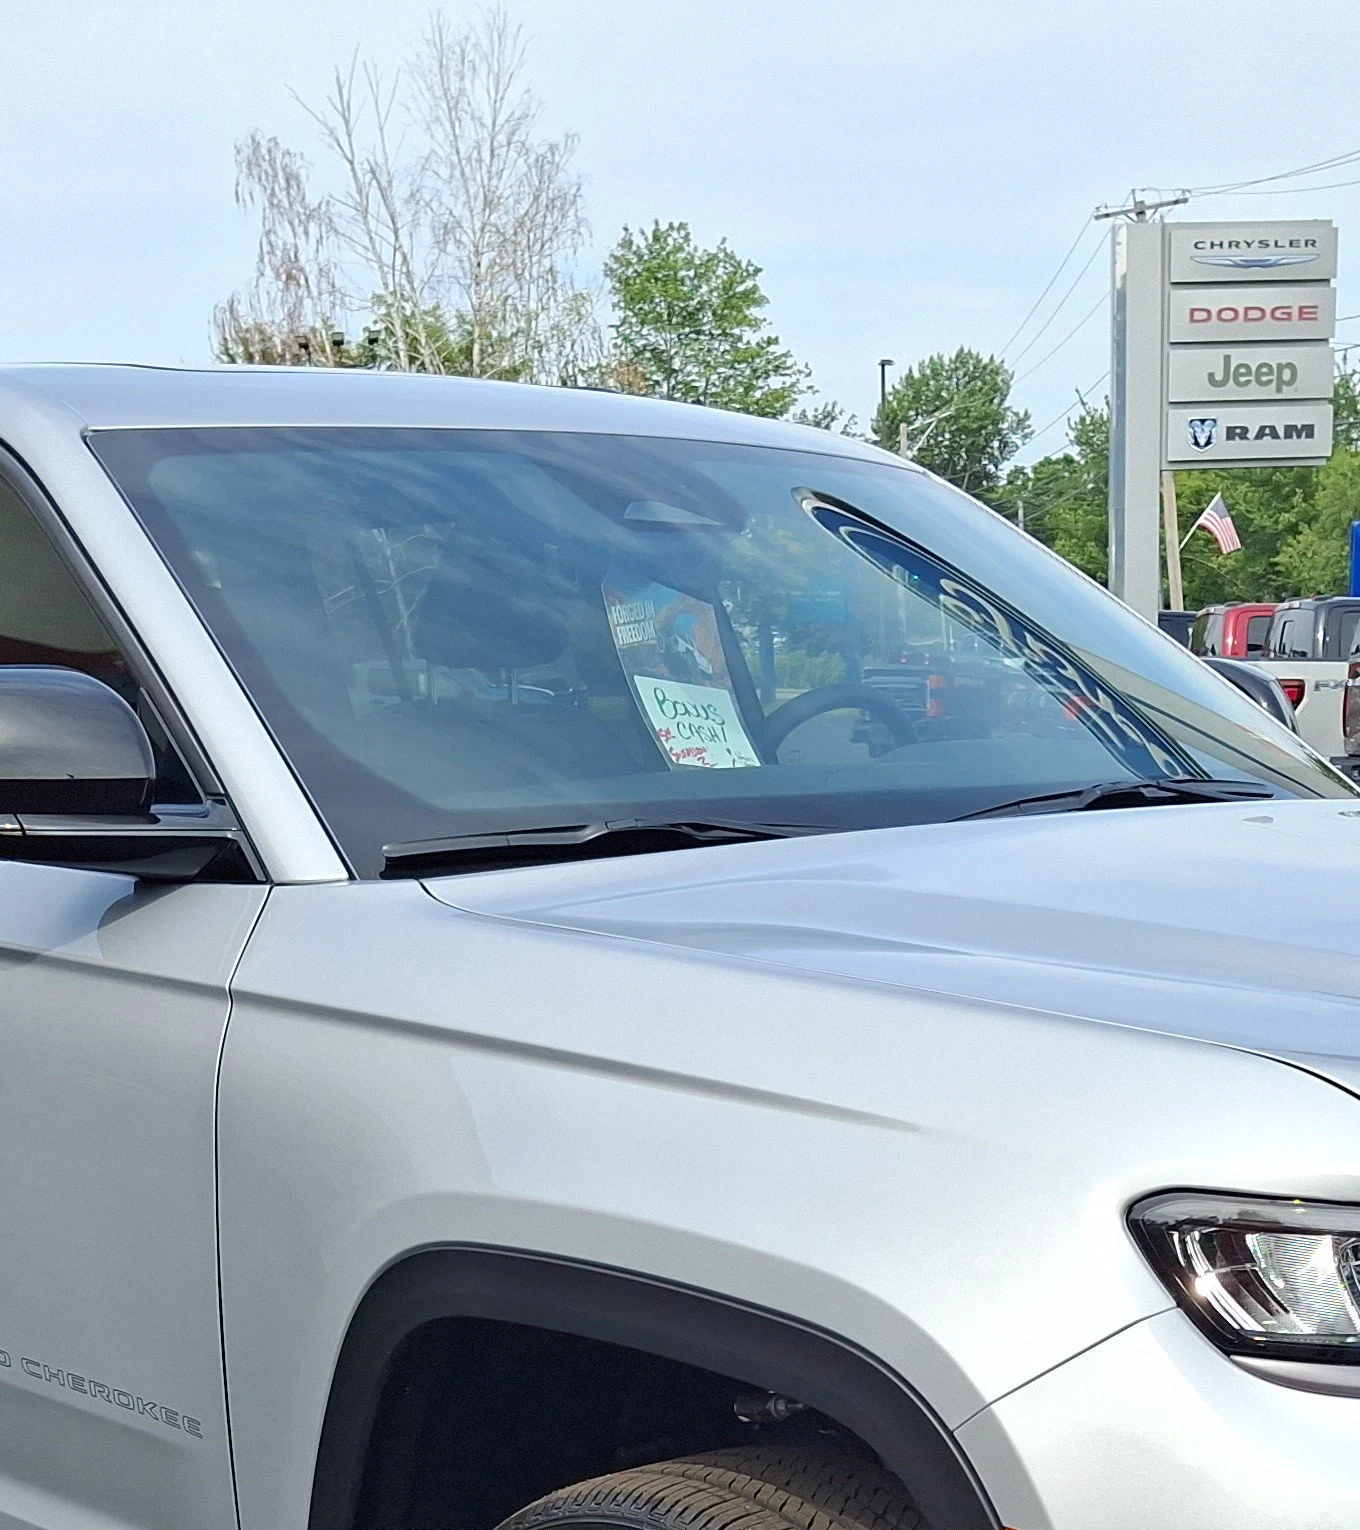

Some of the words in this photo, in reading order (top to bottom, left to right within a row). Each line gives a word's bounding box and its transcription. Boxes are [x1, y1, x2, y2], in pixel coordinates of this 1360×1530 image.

[1193, 236, 1318, 250] CHRYSLER
[1188, 305, 1319, 324] DODGE
[1207, 354, 1298, 394] Jeep
[1225, 423, 1316, 442] RAM
[617, 620, 656, 645] FREEDOM
[20, 1357, 204, 1439] CHEROKEE
